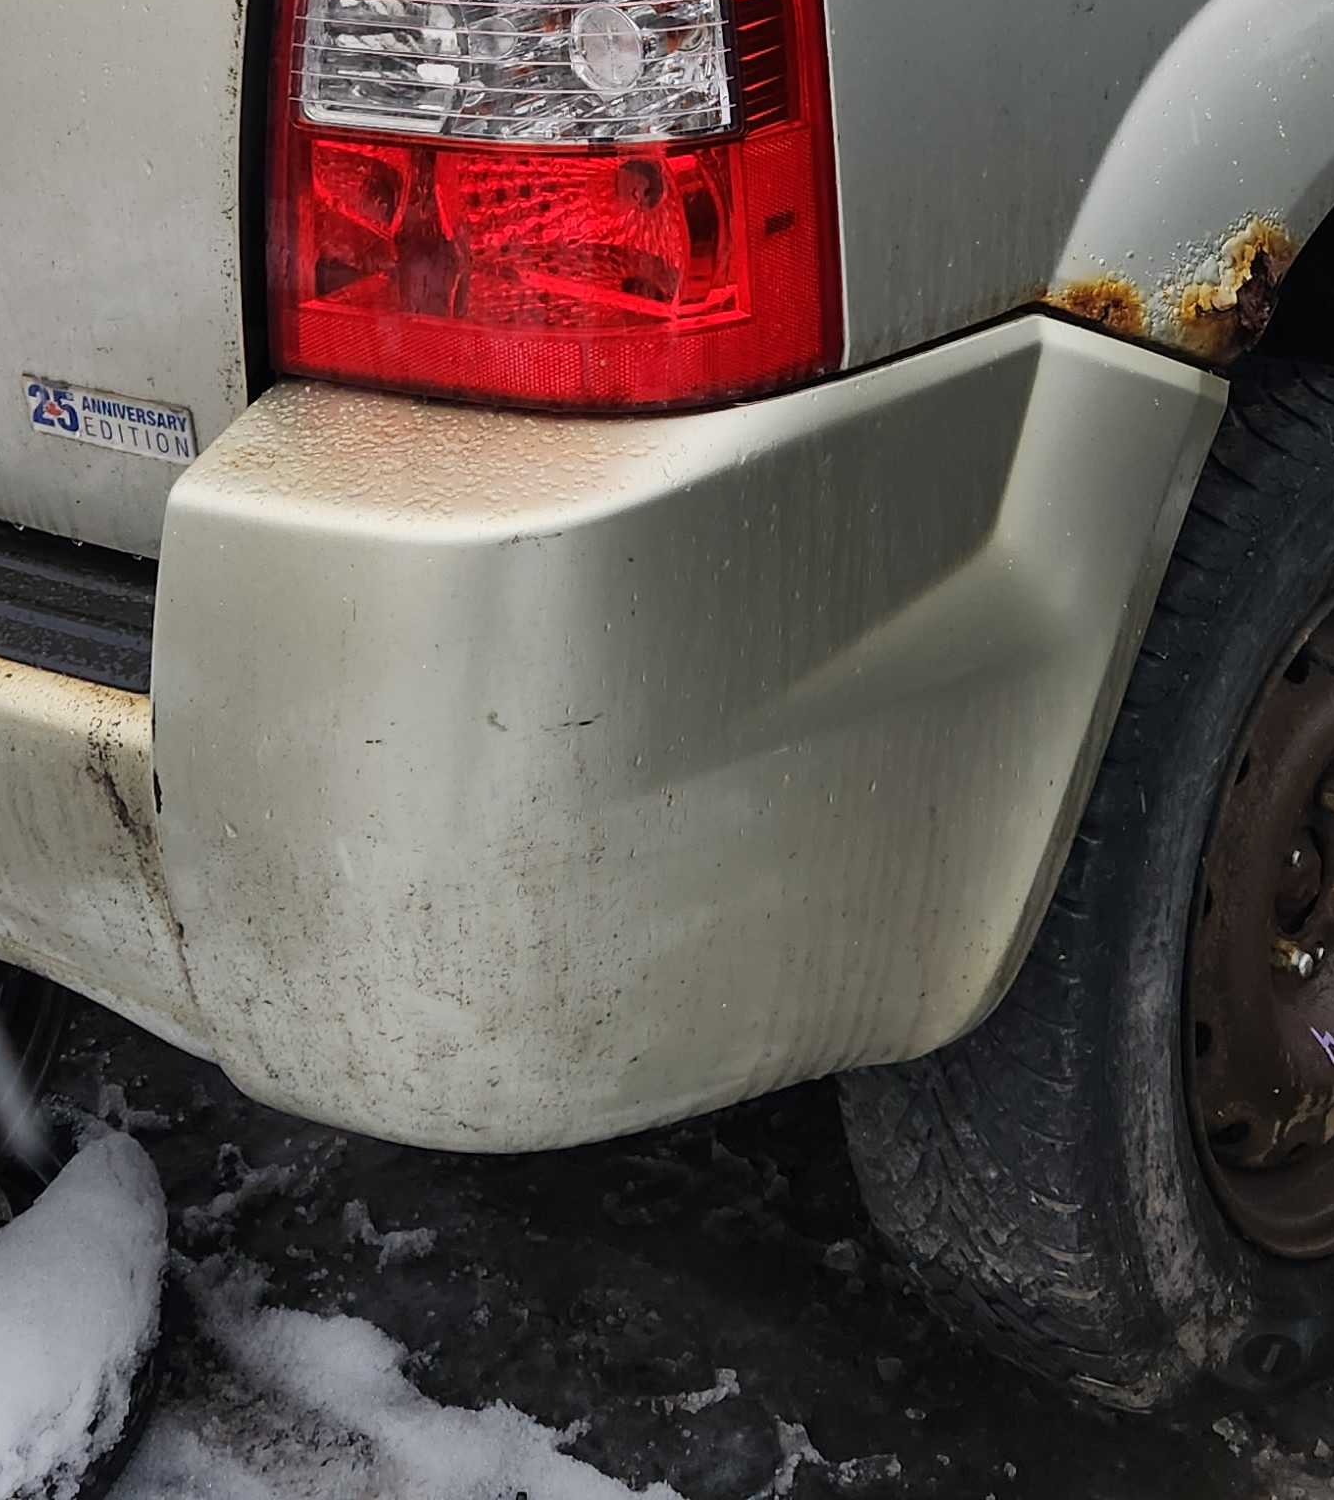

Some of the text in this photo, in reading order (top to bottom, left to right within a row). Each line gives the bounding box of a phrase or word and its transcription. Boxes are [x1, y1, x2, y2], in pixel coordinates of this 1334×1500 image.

[27, 383, 188, 433] 25 ANNIVERSARY
[83, 415, 191, 459] EDITION
